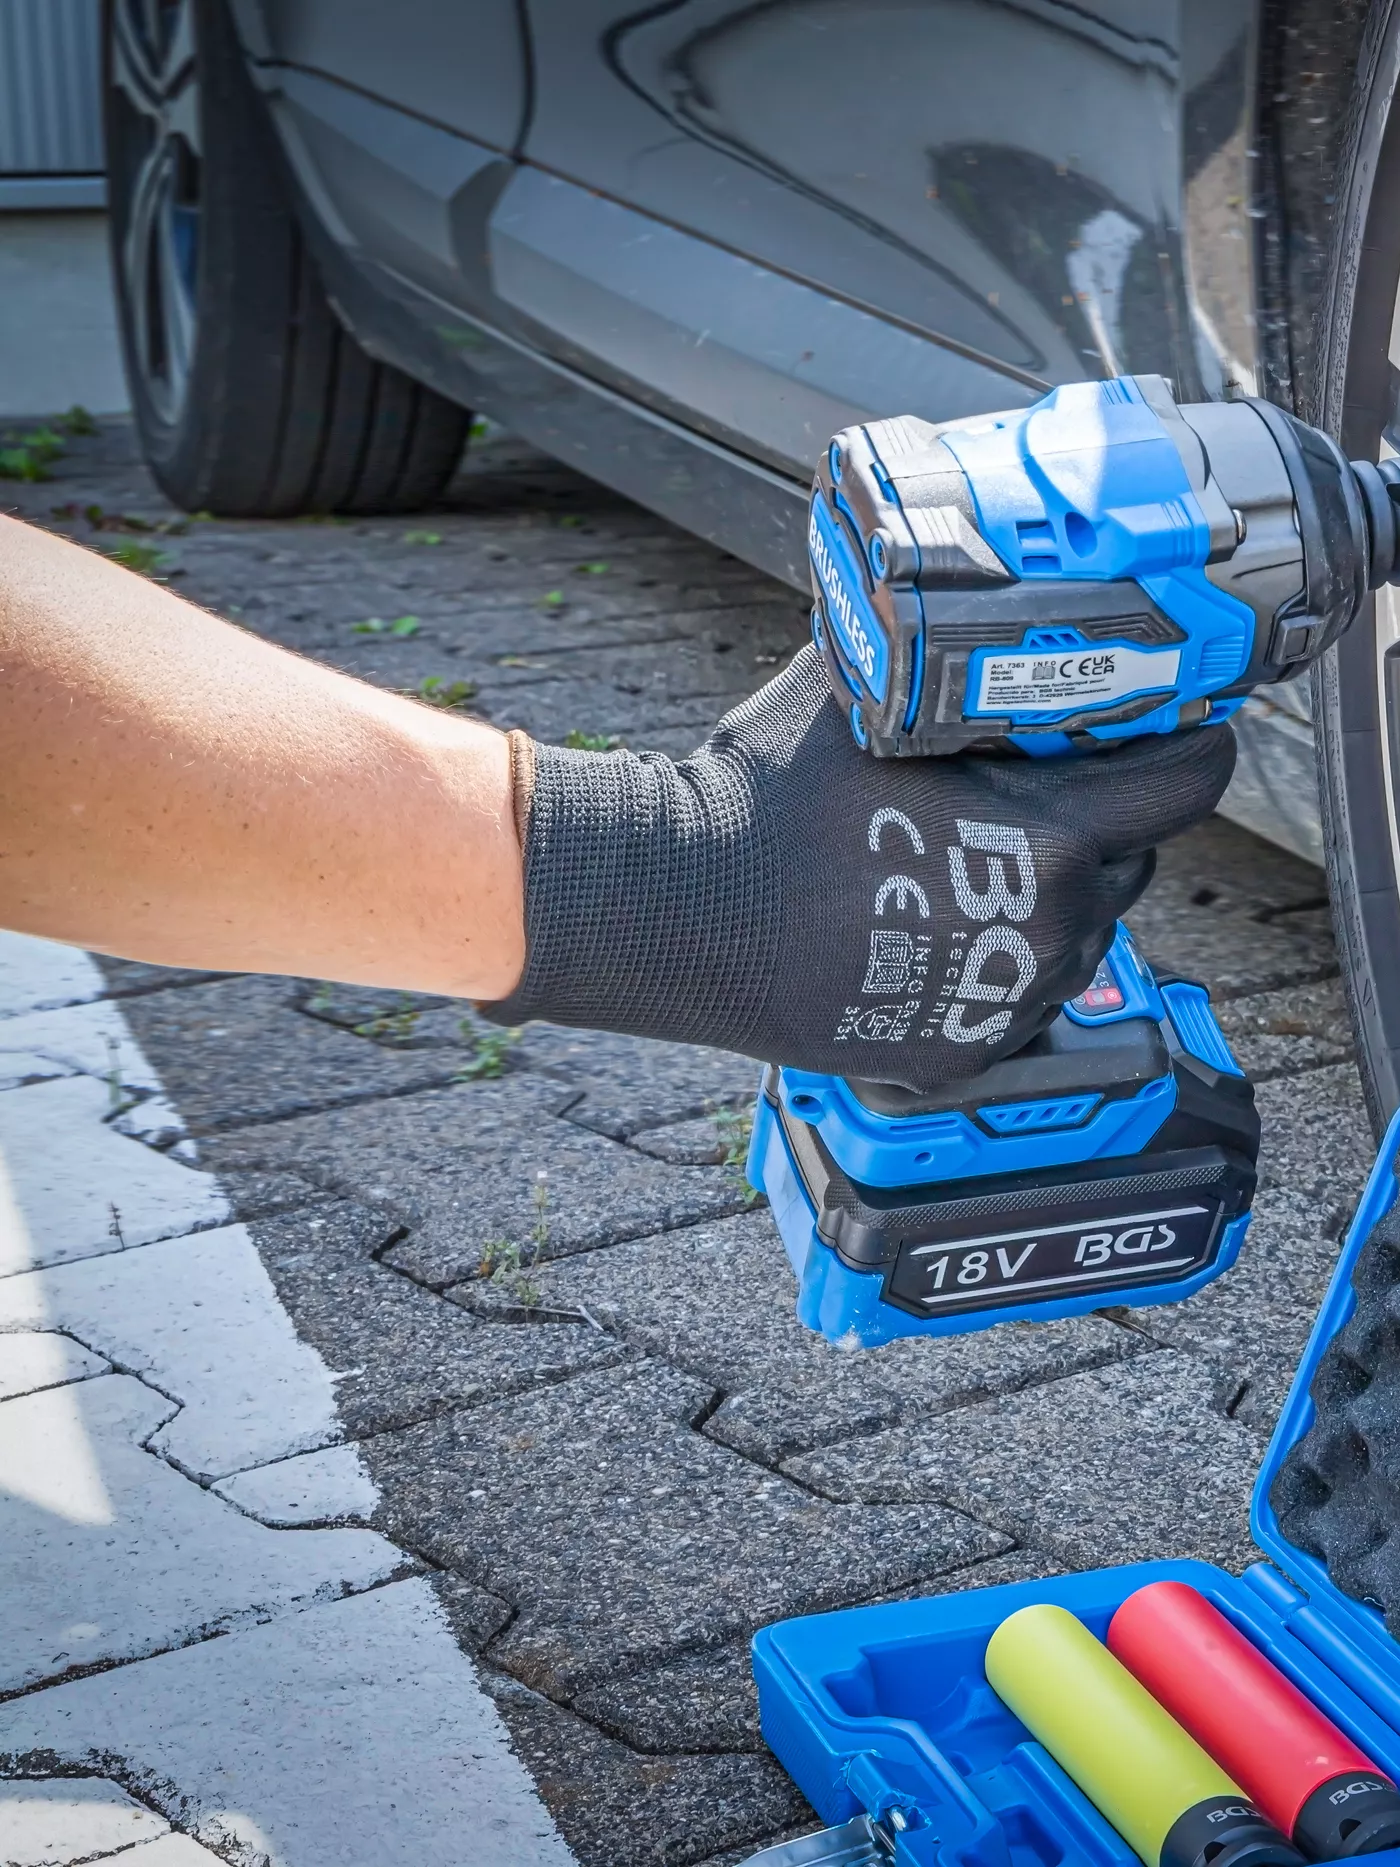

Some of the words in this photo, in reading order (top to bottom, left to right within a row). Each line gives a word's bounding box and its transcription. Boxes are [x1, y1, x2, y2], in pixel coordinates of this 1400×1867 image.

[808, 513, 876, 677] BRUSHLESS
[1091, 665, 1115, 675] CA
[1092, 654, 1116, 666] UK
[942, 818, 1038, 1043] BGS
[907, 934, 932, 993] INFO
[925, 1242, 1037, 1290] 18V
[1073, 1223, 1177, 1267] BGS
[1329, 1781, 1383, 1806] BGS
[1206, 1806, 1262, 1824] BGS
